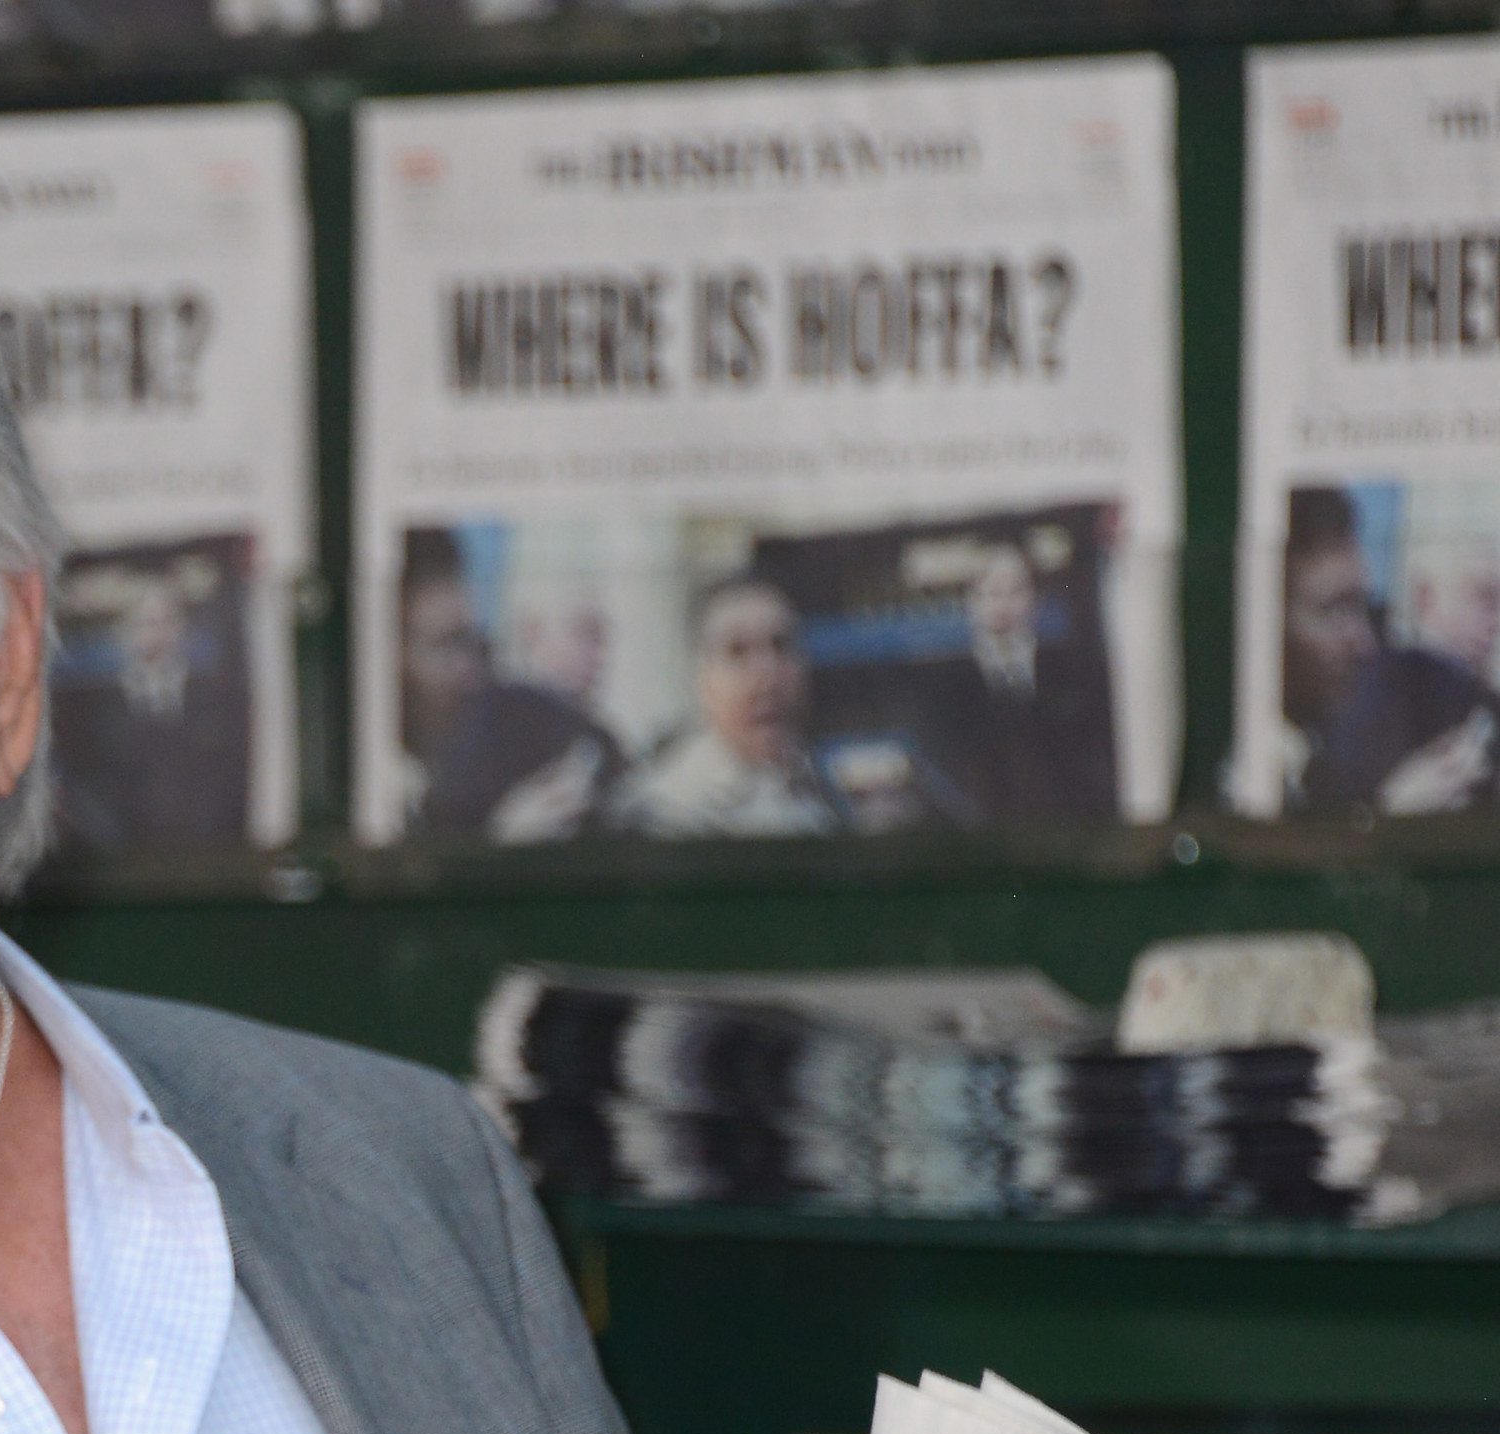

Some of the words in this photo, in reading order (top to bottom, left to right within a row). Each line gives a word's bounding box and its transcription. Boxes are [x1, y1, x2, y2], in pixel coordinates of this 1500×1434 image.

[442, 266, 674, 394] WHERE
[697, 262, 764, 388] IS
[787, 246, 1078, 384] HOFFA?
[1338, 232, 1500, 356] WHE
